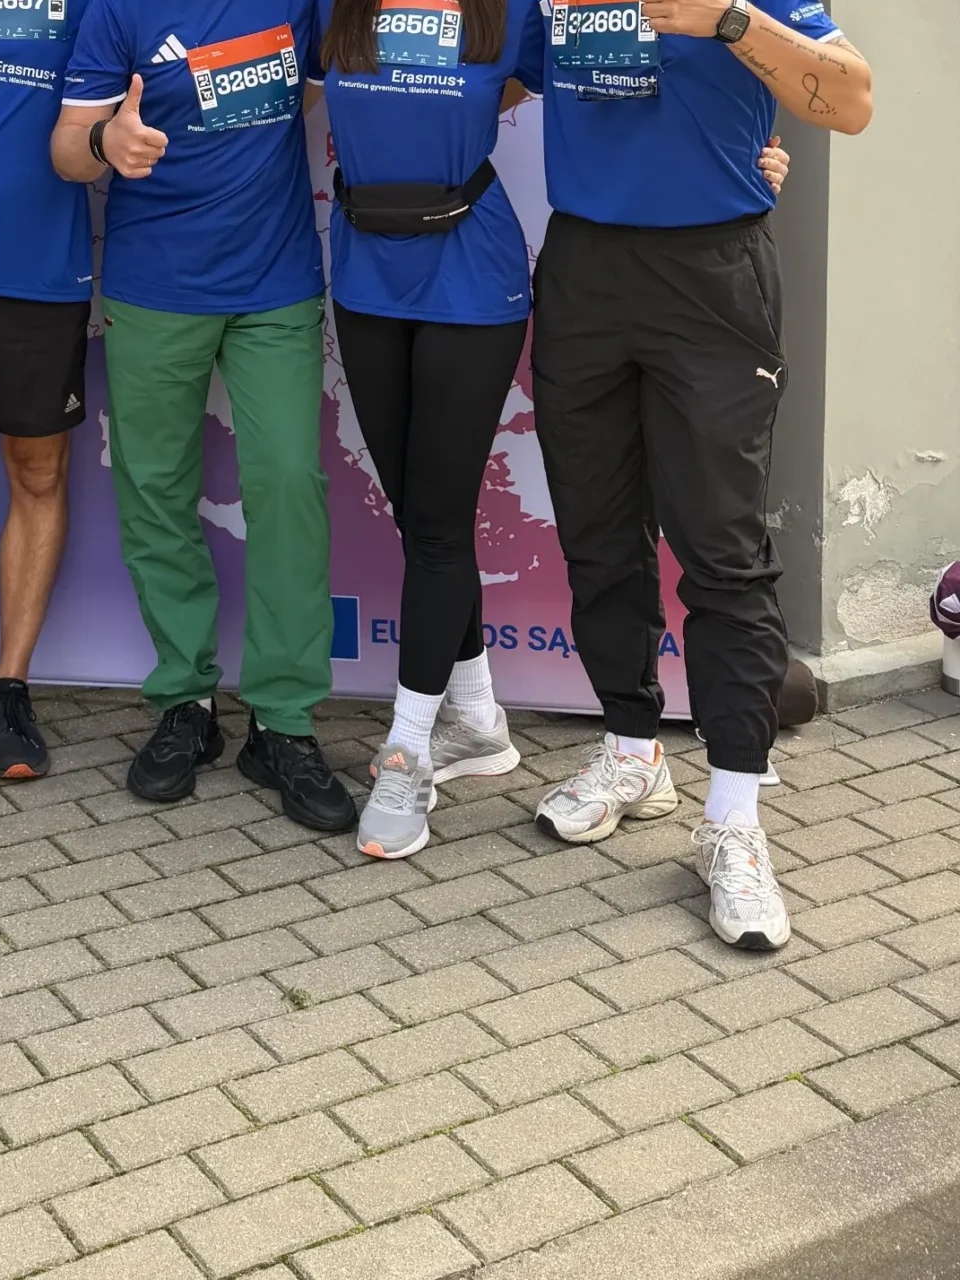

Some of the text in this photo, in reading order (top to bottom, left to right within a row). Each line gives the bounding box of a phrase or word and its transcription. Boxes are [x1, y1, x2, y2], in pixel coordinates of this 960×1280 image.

[568, 8, 637, 34] 32660
[215, 59, 283, 96] 32655
[391, 69, 466, 87] Erasmus+
[592, 70, 657, 88] Erasmus+
